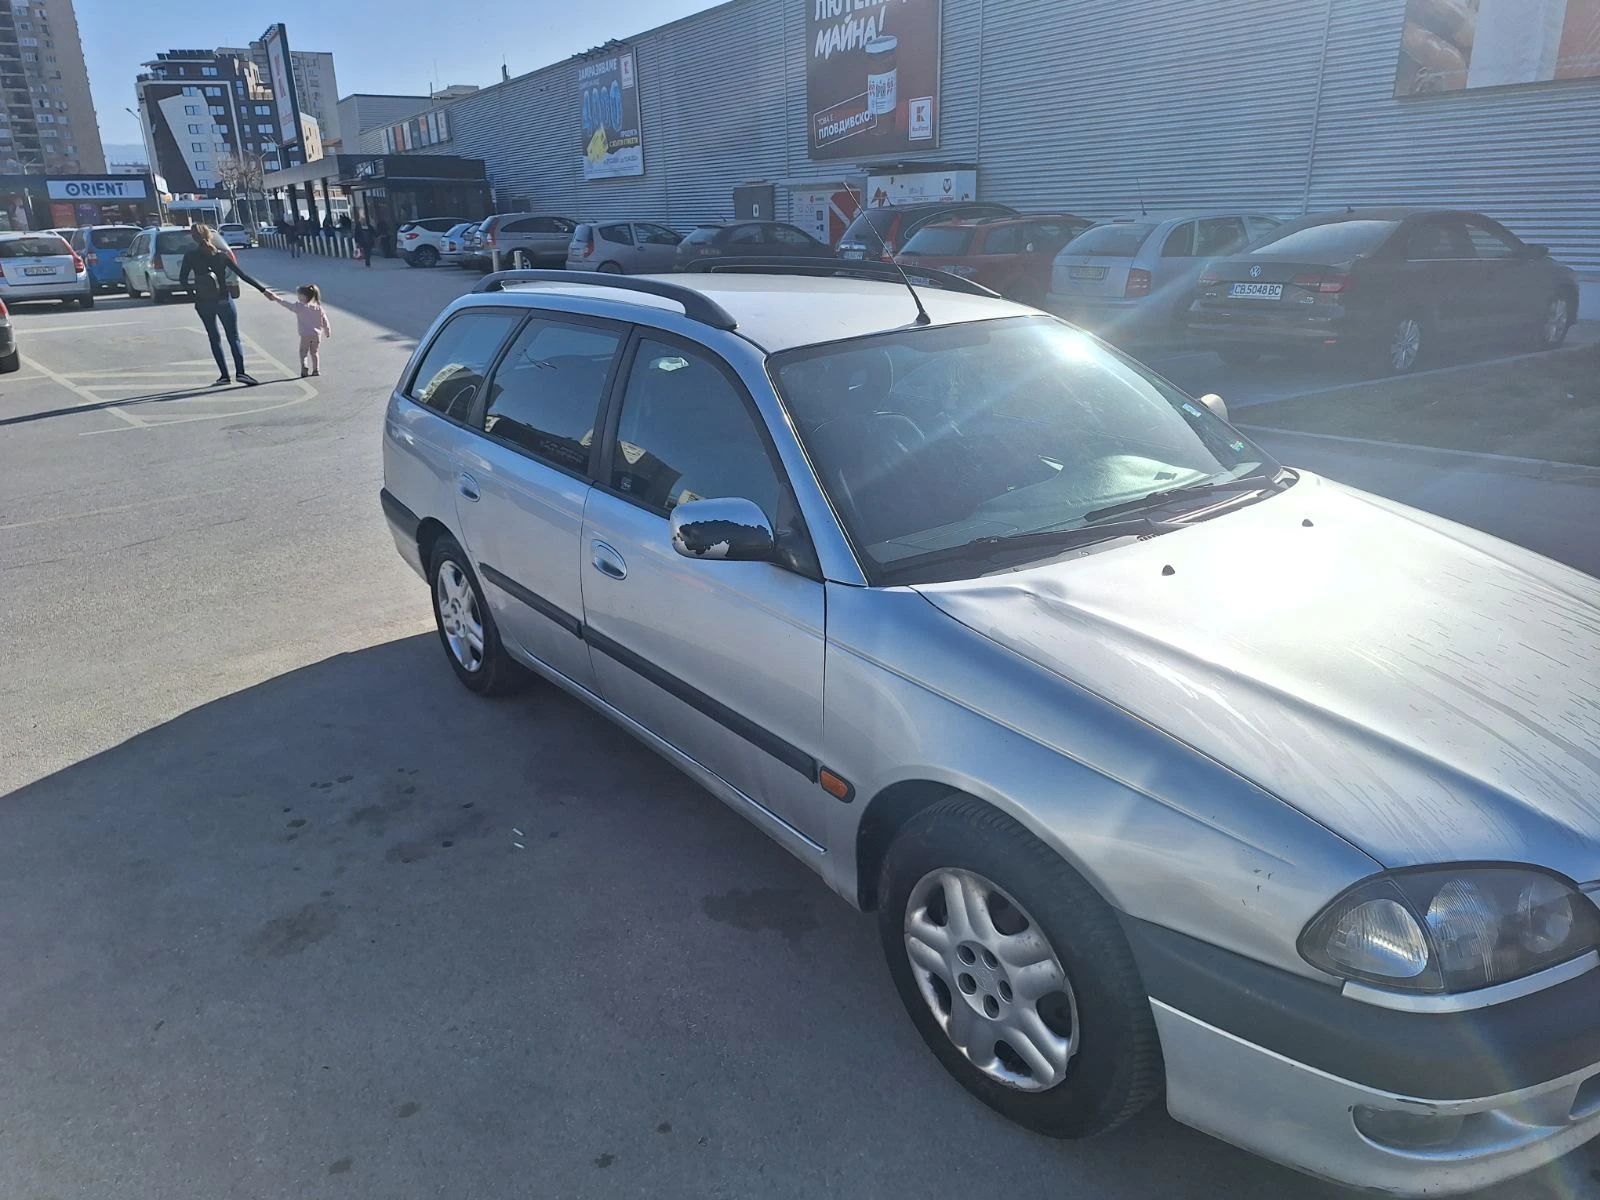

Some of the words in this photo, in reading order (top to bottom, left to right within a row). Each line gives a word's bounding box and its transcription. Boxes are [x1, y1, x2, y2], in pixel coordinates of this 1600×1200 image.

[815, 5, 886, 60] МАЙНА!
[65, 182, 124, 197] ORIENT
[1268, 284, 1281, 296] BC
